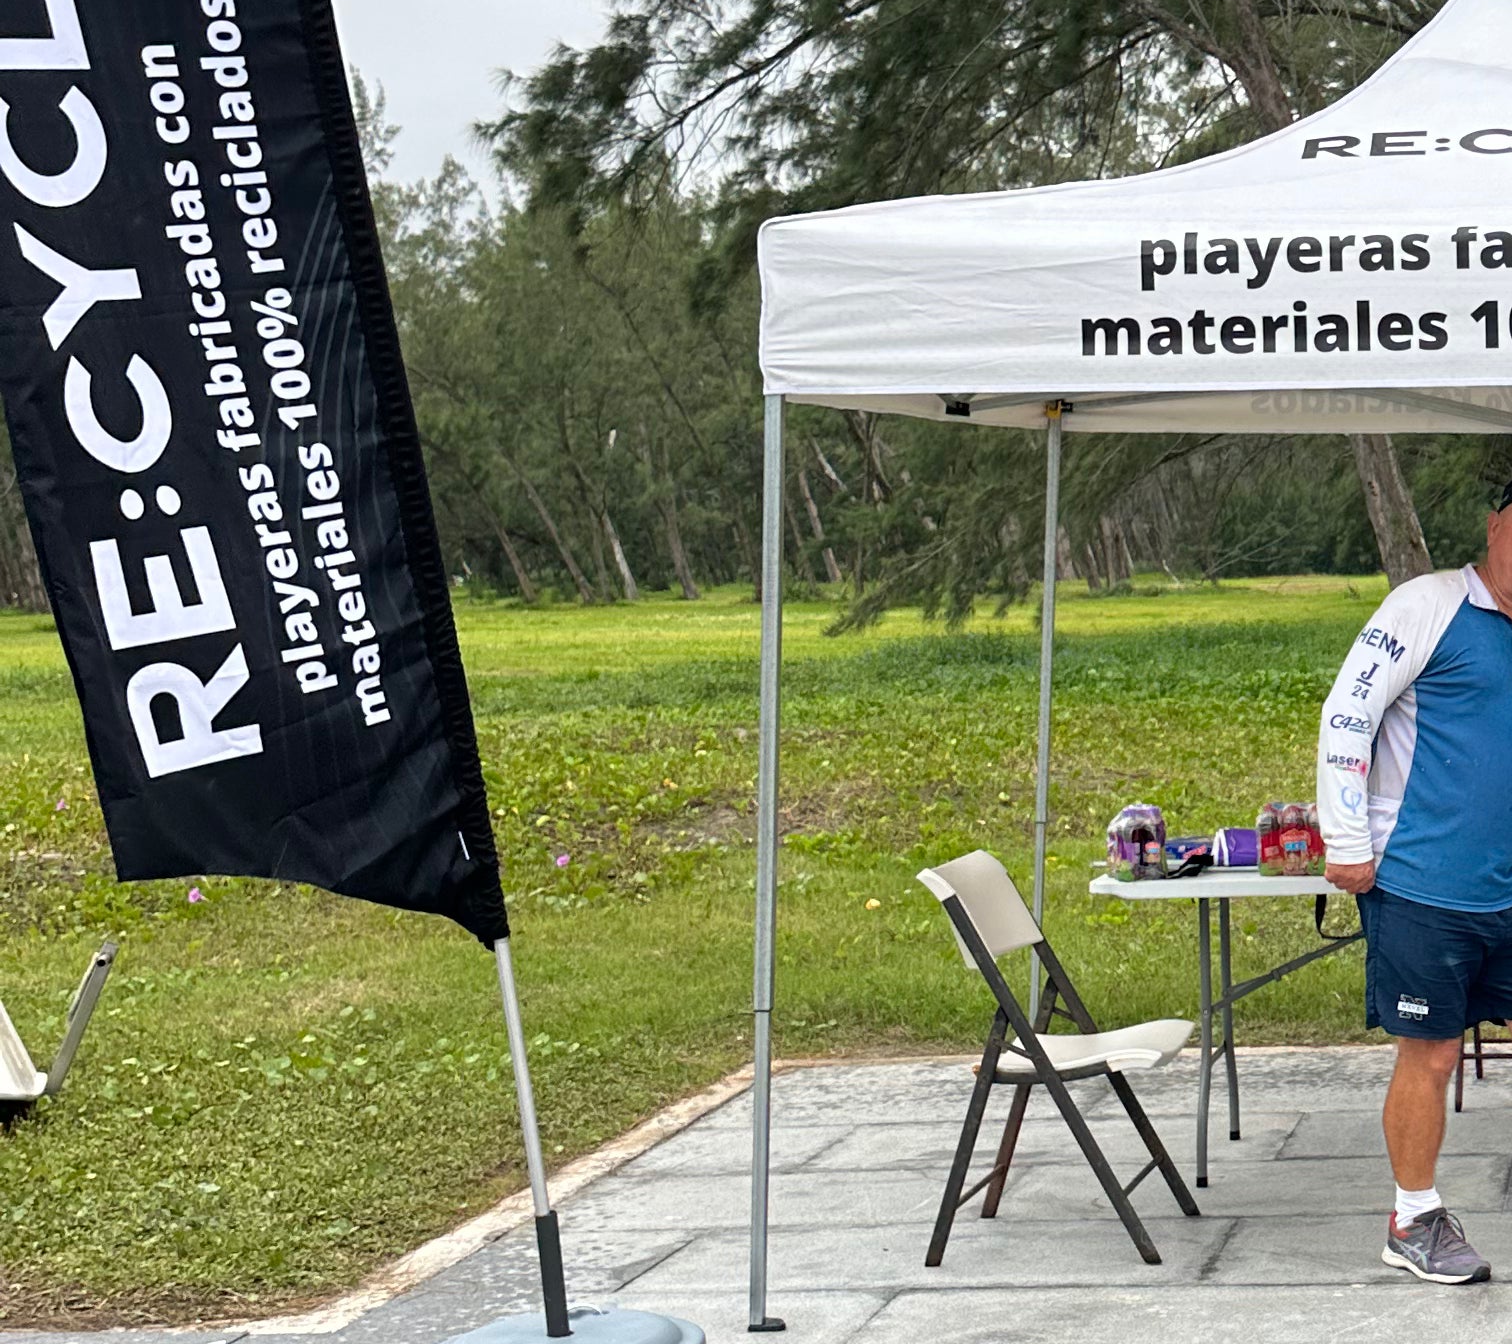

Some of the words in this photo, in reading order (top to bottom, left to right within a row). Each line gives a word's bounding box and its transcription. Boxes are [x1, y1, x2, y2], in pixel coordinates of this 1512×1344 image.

[141, 44, 190, 144] con
[1140, 232, 1431, 292] playeras
[164, 159, 262, 452] fabricadas
[1081, 300, 1448, 356] materiales
[250, 287, 318, 431] 100%
[238, 463, 339, 694] playeras
[297, 442, 391, 726] materiales
[1330, 714, 1371, 729] C420
[1351, 684, 1370, 700] 24
[1326, 752, 1360, 767] Laser
